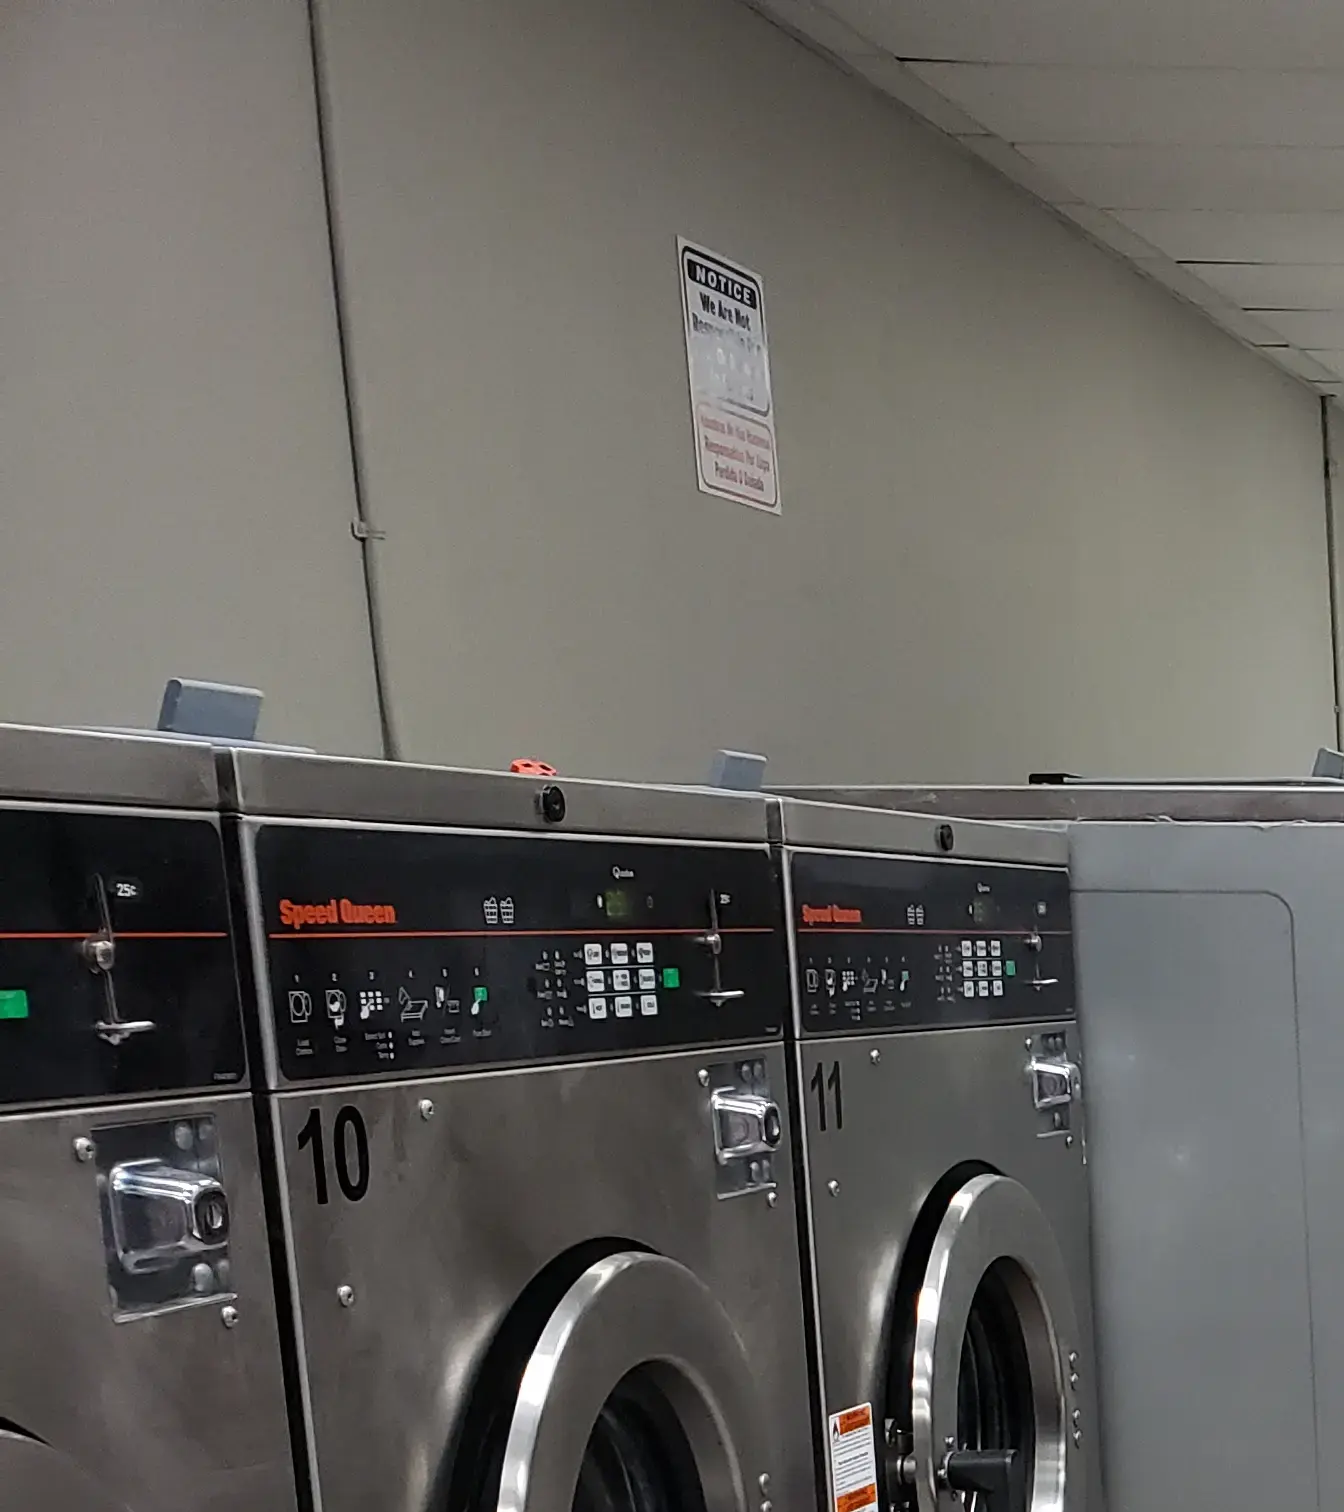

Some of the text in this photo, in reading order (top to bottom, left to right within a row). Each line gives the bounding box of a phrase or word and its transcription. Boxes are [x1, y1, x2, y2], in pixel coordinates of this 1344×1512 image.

[696, 265, 752, 304] NOTICE
[700, 292, 751, 331] We Are Not
[280, 898, 397, 929] Speed Queen
[811, 1061, 842, 1131] 11
[297, 1105, 369, 1204] 10
